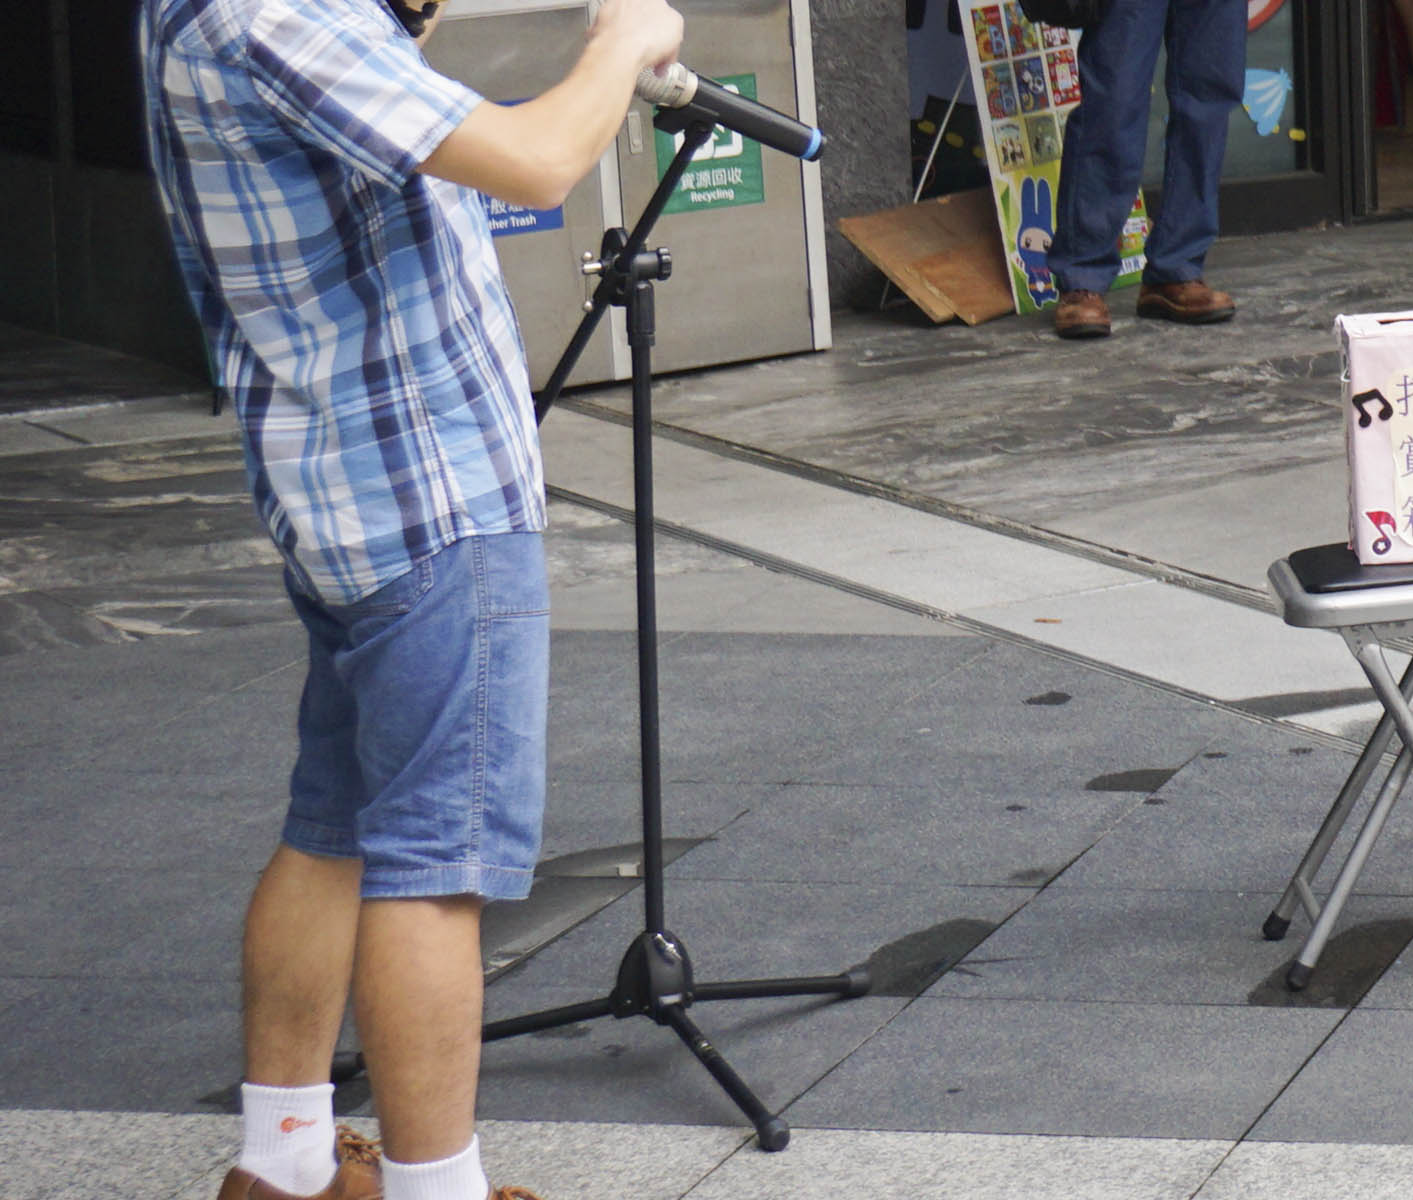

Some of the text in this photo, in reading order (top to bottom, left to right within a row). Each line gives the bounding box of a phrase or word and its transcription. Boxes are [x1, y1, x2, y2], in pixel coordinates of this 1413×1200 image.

[681, 166, 743, 191] 資源回收
[690, 189, 734, 203] Recycling
[488, 213, 537, 231] ther Trash
